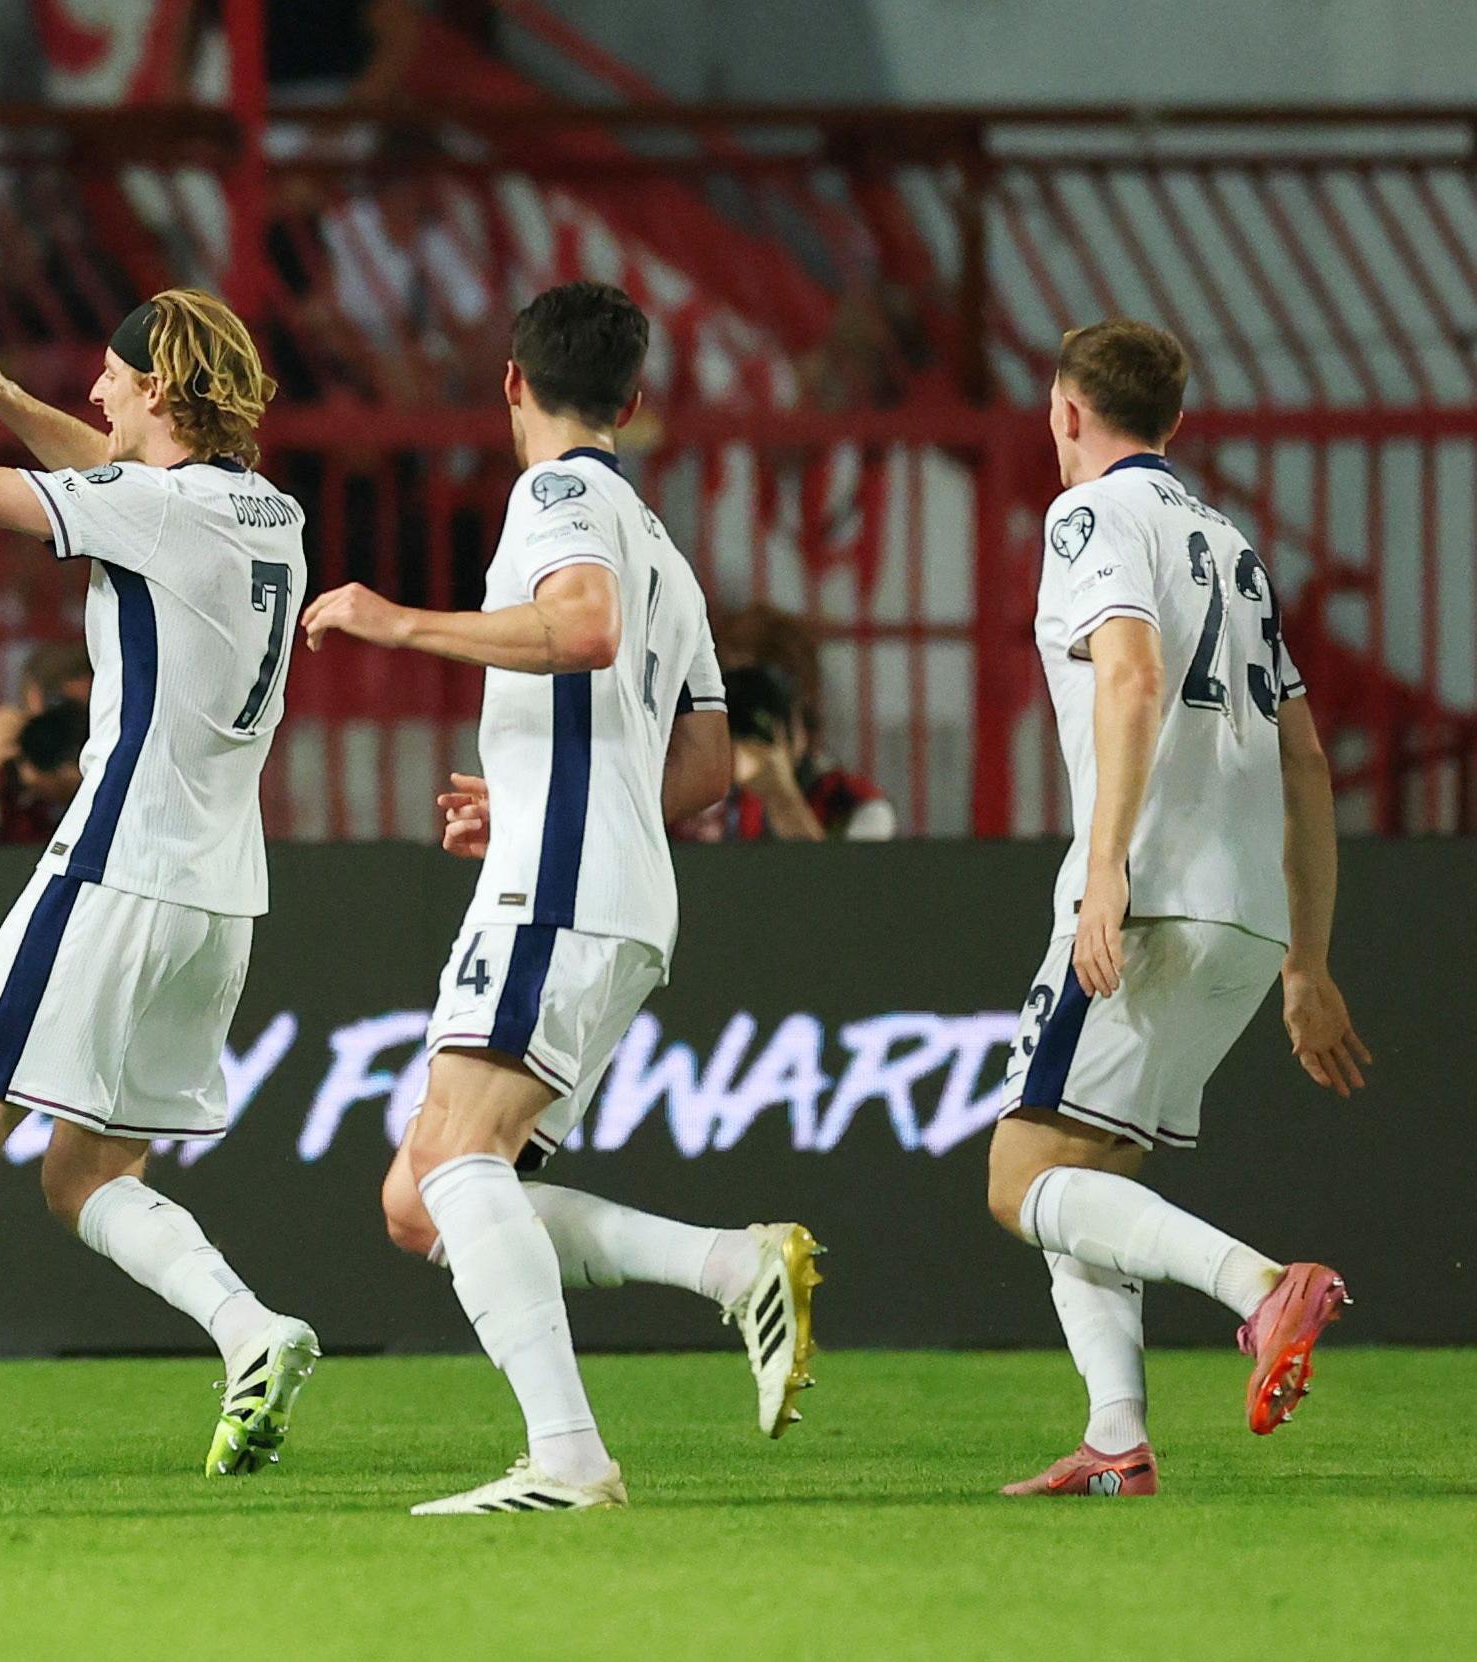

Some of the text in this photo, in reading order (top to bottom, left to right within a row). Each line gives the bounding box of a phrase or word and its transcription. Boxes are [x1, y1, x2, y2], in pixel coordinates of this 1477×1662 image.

[229, 493, 299, 527] GORDON
[232, 560, 292, 736] 7
[1182, 531, 1280, 725] 23
[456, 930, 492, 996] 4
[297, 1010, 1020, 1162] FWARD
